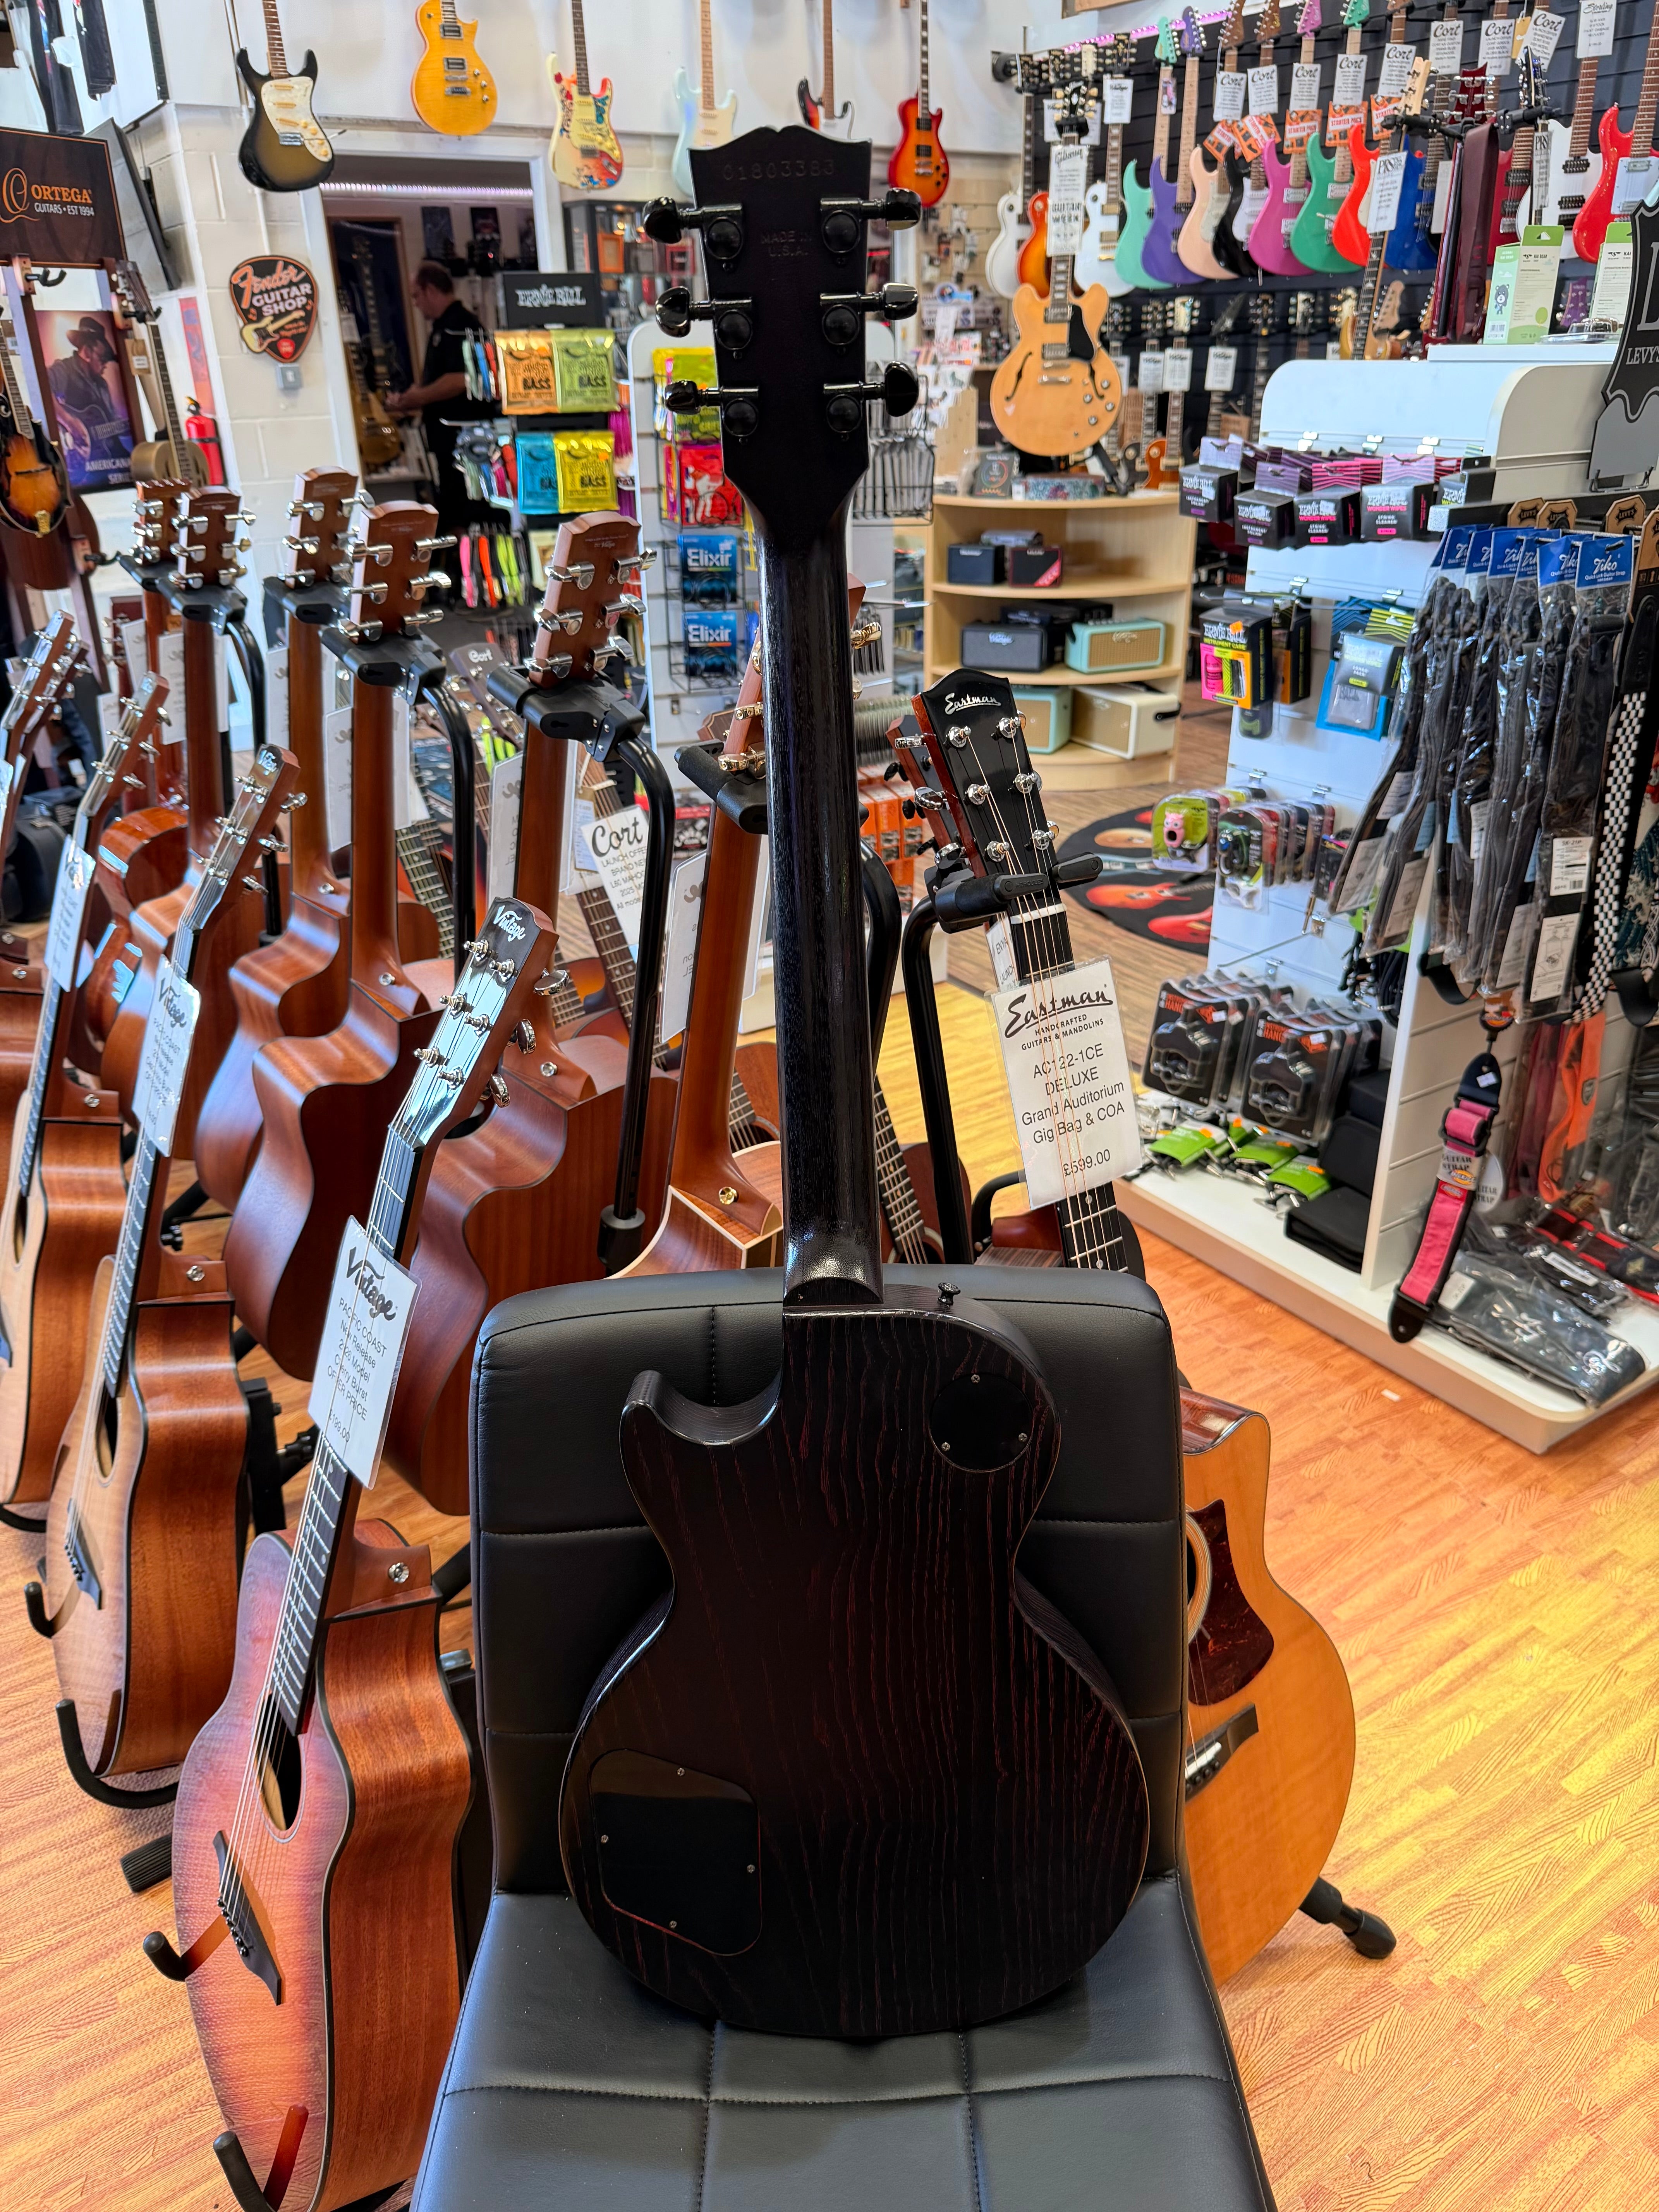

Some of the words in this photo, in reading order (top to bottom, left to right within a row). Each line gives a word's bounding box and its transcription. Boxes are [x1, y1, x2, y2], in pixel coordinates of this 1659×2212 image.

[1433, 24, 1461, 38] Cort
[1486, 22, 1513, 36] Cort
[1534, 13, 1562, 31] Cort
[1340, 57, 1364, 69] Cort
[1386, 46, 1413, 60] Cort
[1221, 74, 1243, 86] Cort
[1251, 69, 1274, 83] Cort
[1295, 66, 1318, 77] Cort
[1331, 118, 1349, 127] STARTER
[1378, 159, 1394, 174] PRS
[31, 184, 92, 204] ORTEGA
[34, 203, 62, 214] GUITARS
[67, 205, 78, 215] EST
[79, 206, 95, 216] 1994
[760, 230, 796, 244] MADE
[231, 260, 307, 309] Fender
[252, 283, 312, 307] GUITAR
[262, 296, 307, 316] SHOP
[1626, 347, 1659, 365] LEVY'
[108, 472, 131, 484] SERIE
[1368, 491, 1389, 506] ERNIE
[687, 548, 732, 567] Elixir
[1593, 555, 1618, 574] Tiko
[688, 624, 732, 642] Elixir
[1203, 622, 1226, 640] ERNIE
[1203, 637, 1231, 648] INSTRUMENT
[945, 692, 1001, 715] Eastman
[591, 817, 643, 857] Cort
[601, 854, 628, 868] LAUNCH
[629, 846, 647, 858] OFFE
[611, 863, 634, 876] BRAND
[493, 905, 526, 942] Vintage
[1005, 988, 1113, 1038] Eastman
[1021, 1036, 1052, 1051] GUITARS
[1061, 1018, 1104, 1037] MANDOLINS
[1035, 1014, 1087, 1036] HANDCRAFTED
[1033, 1043, 1104, 1079] AC122-1CE
[1045, 1066, 1099, 1096] DELUXE
[1022, 1103, 1059, 1126] Grand
[1063, 1082, 1124, 1112] Auditorium
[1033, 1127, 1054, 1144] Gig
[1058, 1119, 1082, 1136] Bag
[1086, 1112, 1094, 1125] &
[1097, 1101, 1125, 1121] COA
[1063, 1149, 1111, 1177] £599.00
[346, 1246, 397, 1321] Vintage
[339, 1297, 362, 1331] PACIFIC
[362, 1326, 387, 1357] COAST
[341, 1320, 352, 1340] New
[352, 1336, 376, 1369] Release
[352, 1355, 370, 1383] Model
[351, 1374, 368, 1402] Burst
[346, 1391, 367, 1421] PRICE
[328, 1408, 350, 1444] £199.00
